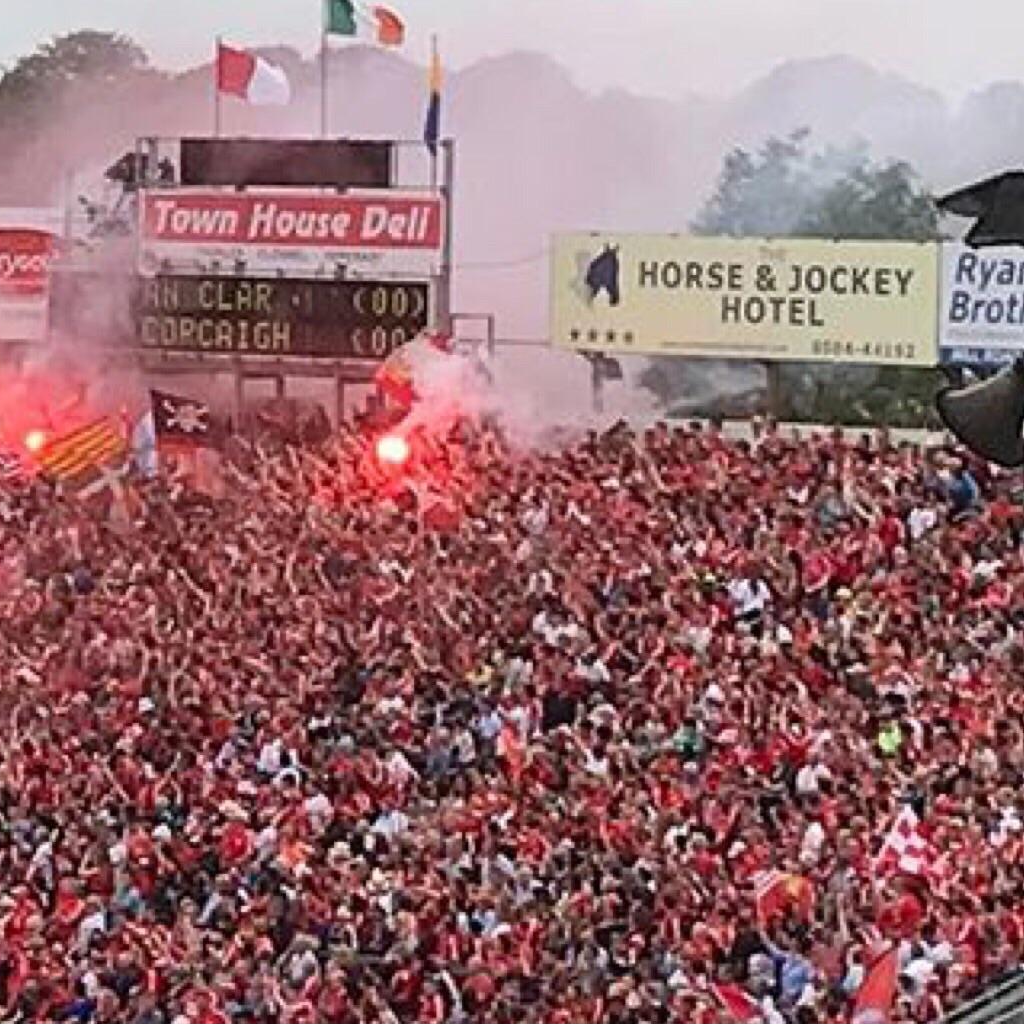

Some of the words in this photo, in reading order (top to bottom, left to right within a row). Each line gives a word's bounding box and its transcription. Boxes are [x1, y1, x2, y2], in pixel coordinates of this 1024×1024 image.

[153, 200, 239, 235] Town
[247, 203, 351, 239] House
[360, 207, 431, 241] Deli
[639, 261, 743, 291] HORSE
[756, 264, 777, 292] &
[789, 264, 915, 296] JOCKEY
[198, 280, 273, 313] CLAR
[721, 296, 826, 327] HOTEL
